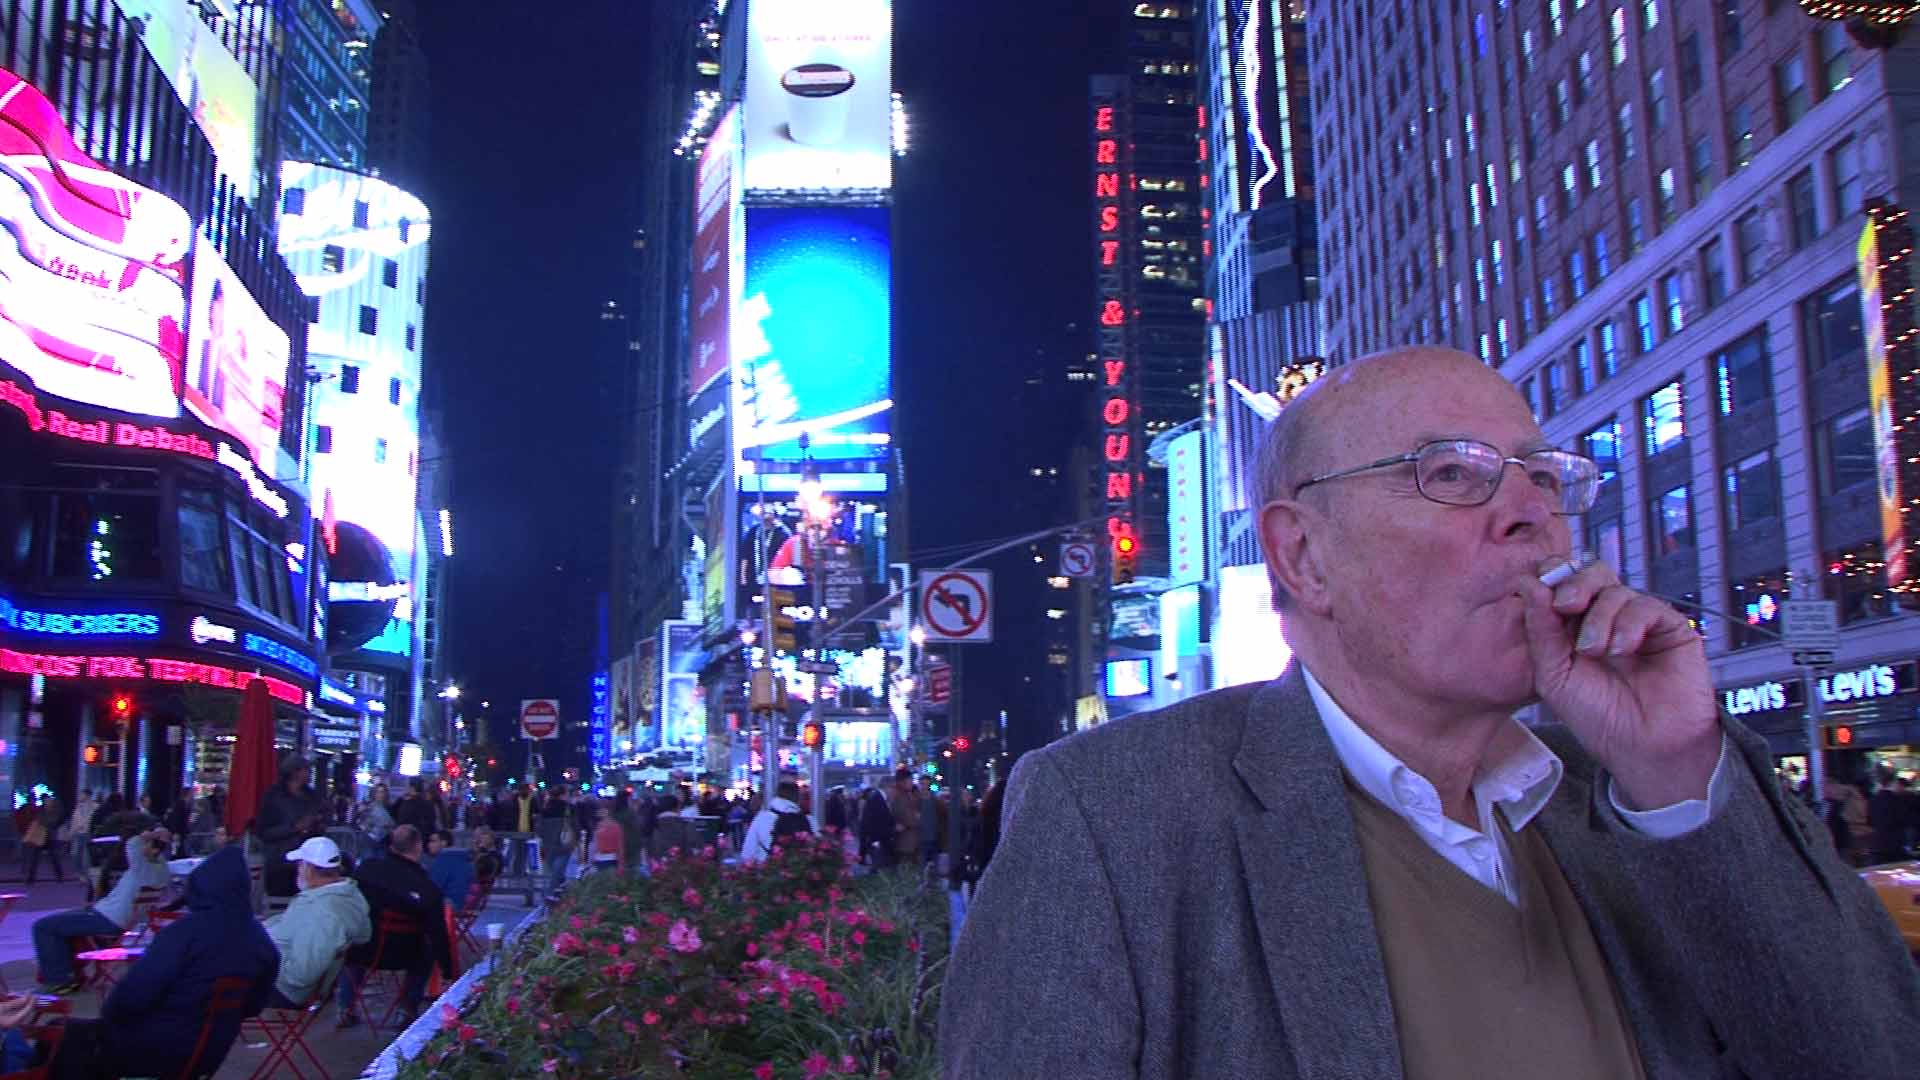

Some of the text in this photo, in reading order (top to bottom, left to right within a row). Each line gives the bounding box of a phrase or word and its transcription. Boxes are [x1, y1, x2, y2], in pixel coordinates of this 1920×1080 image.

[1096, 107, 1119, 265] ERNST
[1101, 300, 1125, 326] &
[47, 410, 217, 460] Real Debate
